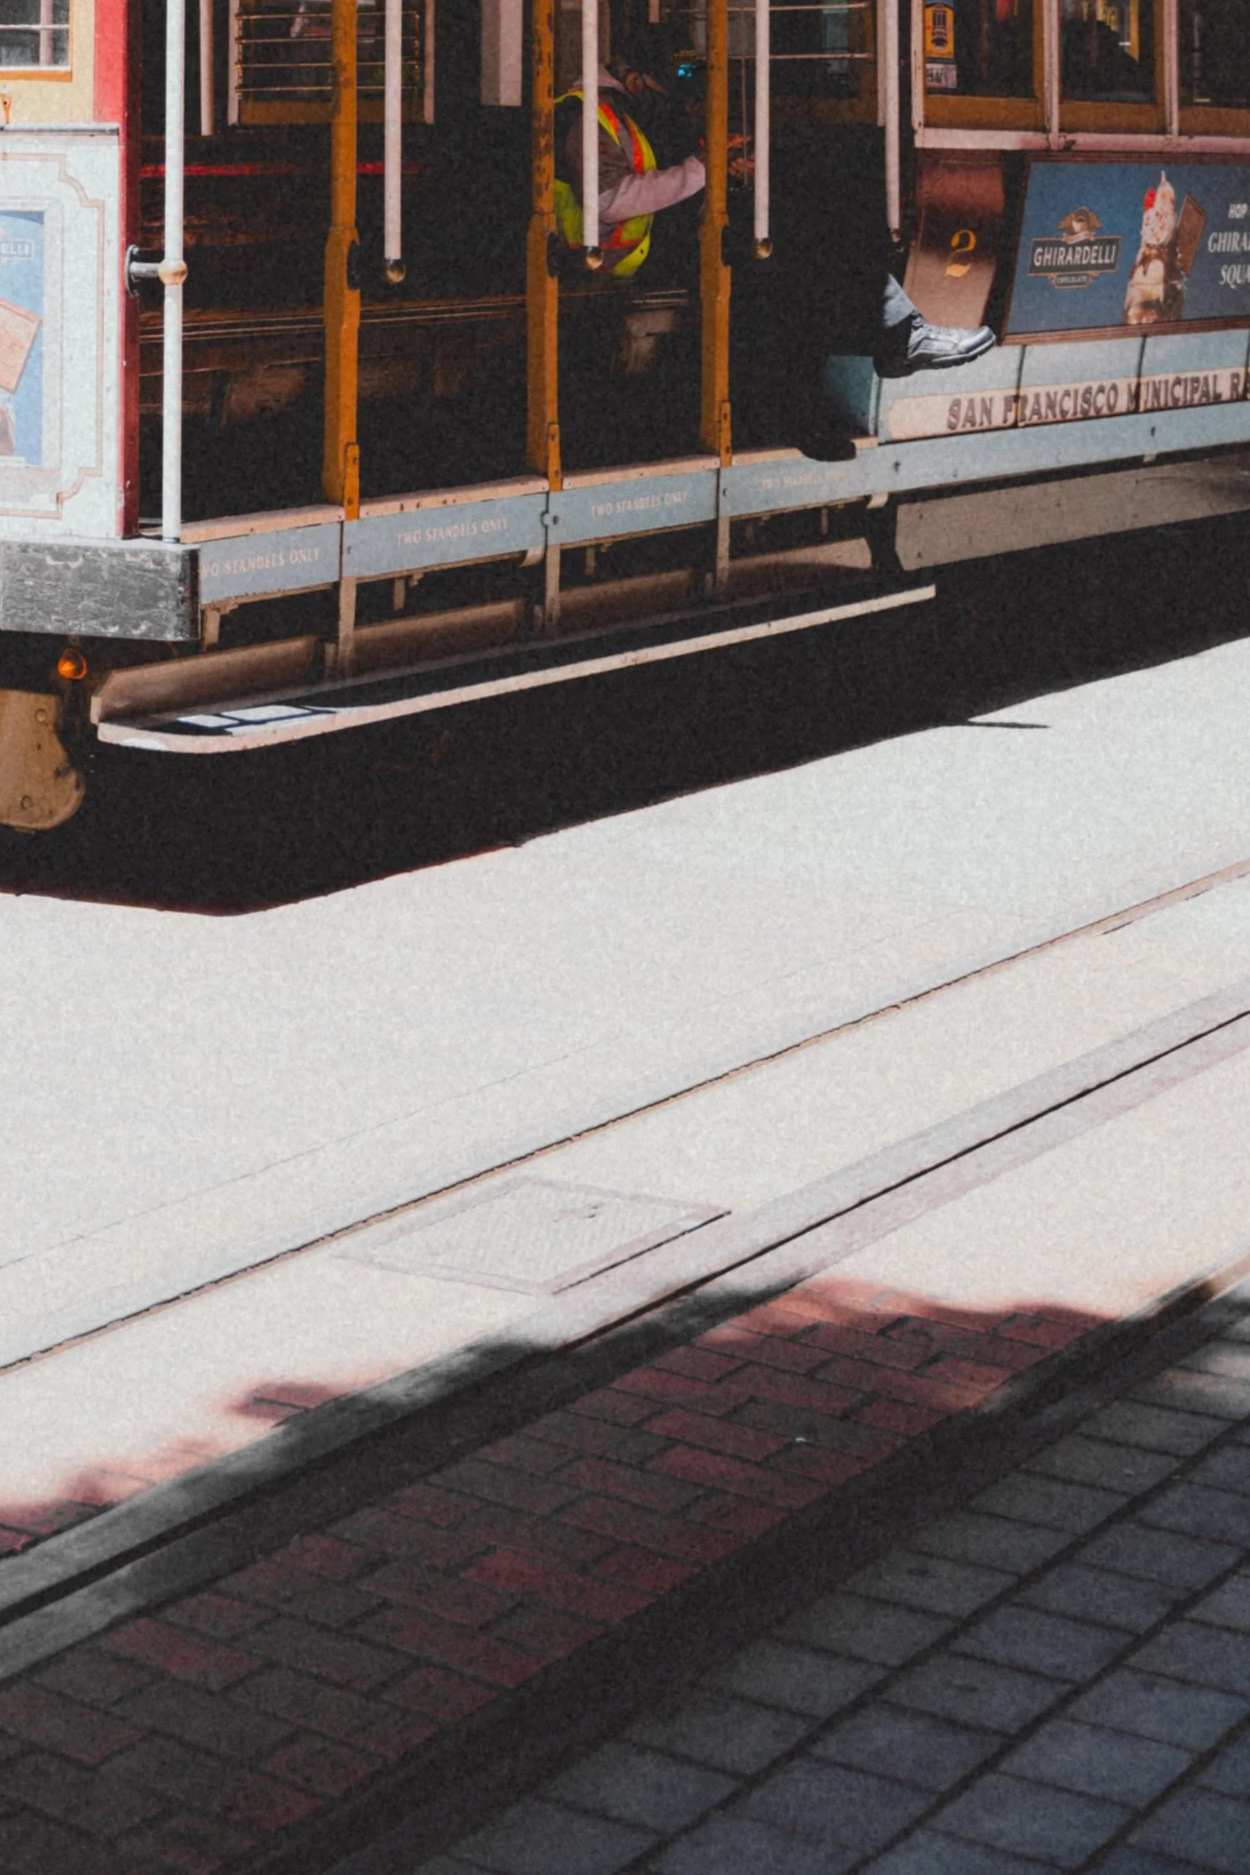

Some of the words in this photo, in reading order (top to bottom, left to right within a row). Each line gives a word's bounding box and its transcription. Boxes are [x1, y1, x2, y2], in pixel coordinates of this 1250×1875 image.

[1229, 203, 1248, 219] HOP
[944, 229, 977, 278] 2
[1033, 245, 1117, 267] GHIRARDELLI
[946, 397, 993, 430] SAN
[1002, 383, 1118, 425] FRANCISCO
[590, 503, 612, 518] TWO
[664, 491, 687, 506] ONLY
[397, 531, 421, 546] TWO
[426, 521, 478, 542] STANDEES
[481, 517, 510, 533] ONLY
[199, 563, 219, 577] WO
[225, 553, 284, 575] STANDEES
[289, 546, 322, 563] ONLY
